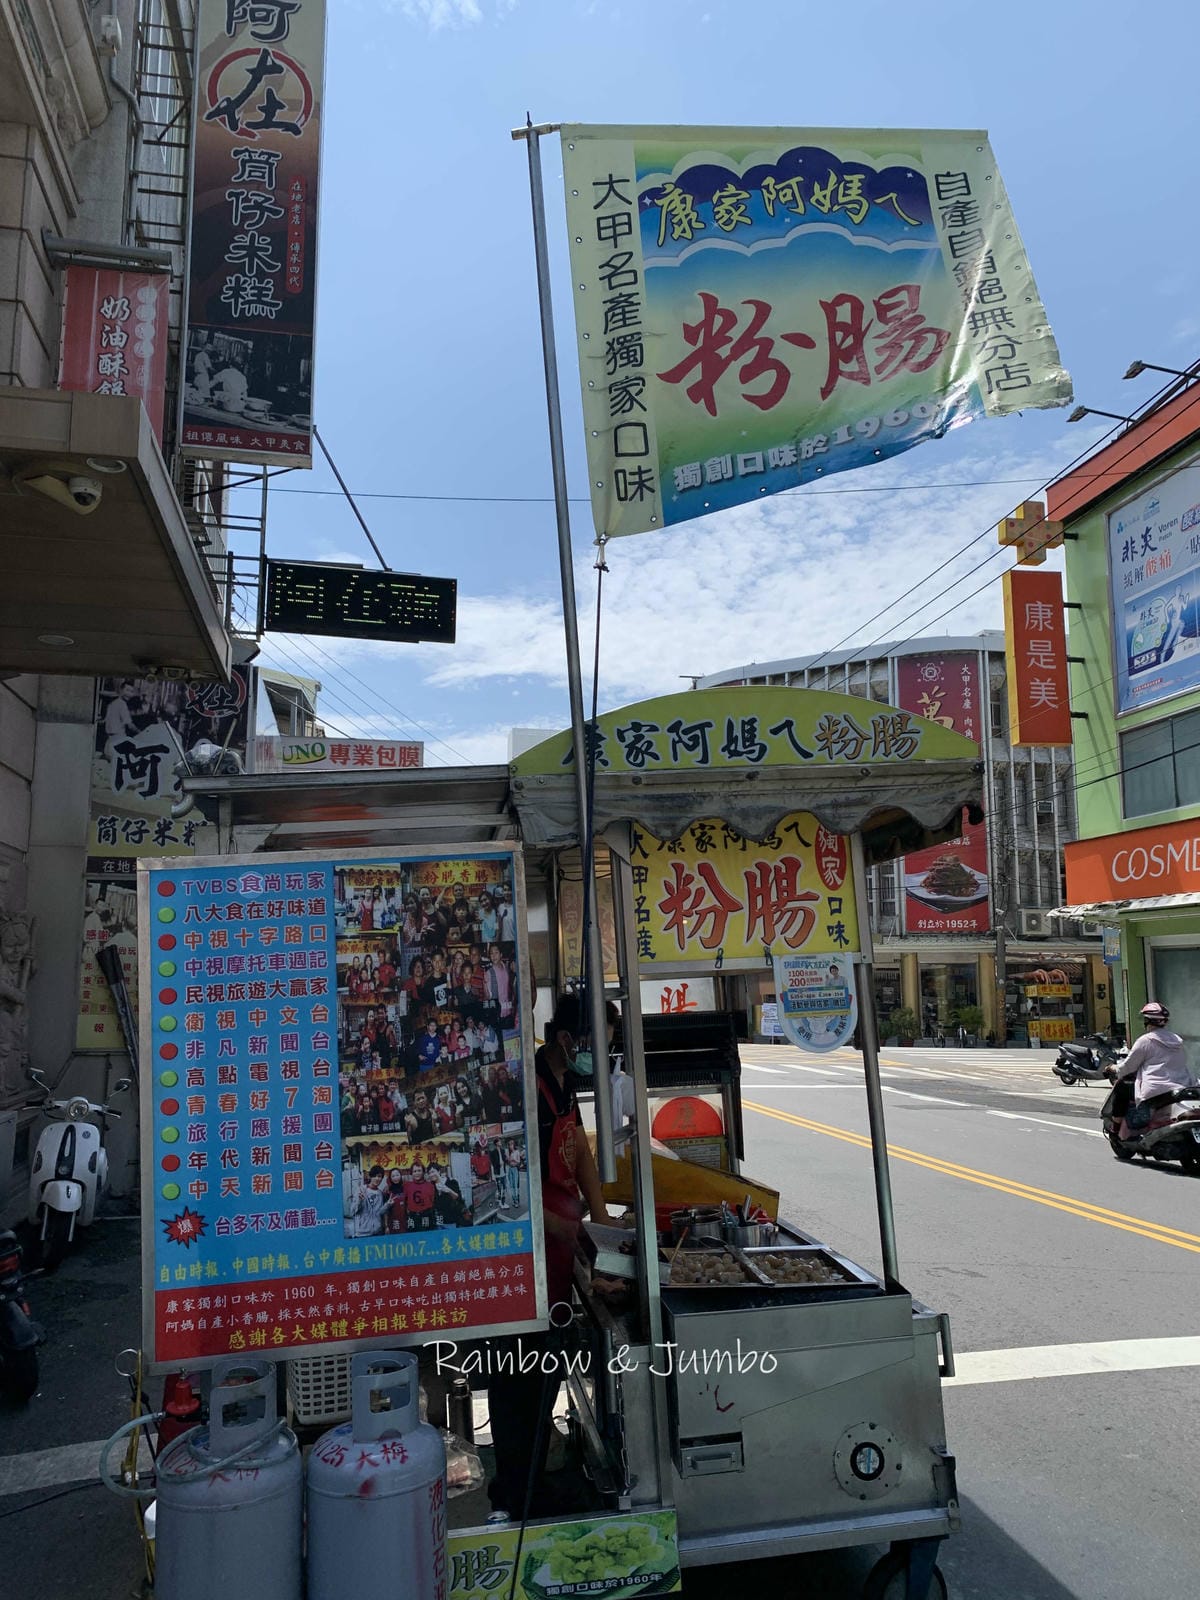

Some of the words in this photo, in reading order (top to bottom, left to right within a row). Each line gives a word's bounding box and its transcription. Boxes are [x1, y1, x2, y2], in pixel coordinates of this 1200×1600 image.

[221, 147, 285, 319] 筒仔米糕
[592, 173, 656, 503] 大甲名產獨家口味
[656, 284, 951, 417] 粉腸
[185, 430, 243, 445] 祖傳風味
[249, 437, 306, 452] 大甲美食
[673, 394, 962, 493] 獨創口味於1960
[1024, 601, 1059, 709] 康是美
[960, 663, 973, 710] 大甲名產
[283, 741, 326, 762] UNO
[328, 743, 421, 768] 專業包膜
[103, 859, 137, 873] 在地
[1111, 837, 1200, 882] COSME
[182, 871, 326, 895] TVBS食尚玩家
[183, 897, 327, 923] 八大食在好味道
[657, 855, 820, 950] 粉腸
[184, 924, 328, 950] 中視十字路口
[917, 918, 979, 930] 創立於1952年
[184, 950, 328, 977] 中視摩托車週記
[185, 978, 329, 1004] 民視旅遊大贏家
[185, 1004, 329, 1032] 衛視中文台
[186, 1031, 330, 1059] 非凡新聞台
[186, 1058, 331, 1087] 高點電視台
[187, 1086, 332, 1115] 青春好7淘
[187, 1112, 332, 1143] 旅行應援團
[188, 1142, 333, 1171] 年代新聞台
[188, 1169, 334, 1200] 中天新聞台
[164, 1291, 274, 1314] 康家獨創口味於
[283, 1285, 316, 1300] 1960
[229, 1307, 468, 1350] 感謝各大媒體爭相報導採訪
[450, 1545, 514, 1592] 腸
[545, 1573, 664, 1597] 獨創口味於1960年
